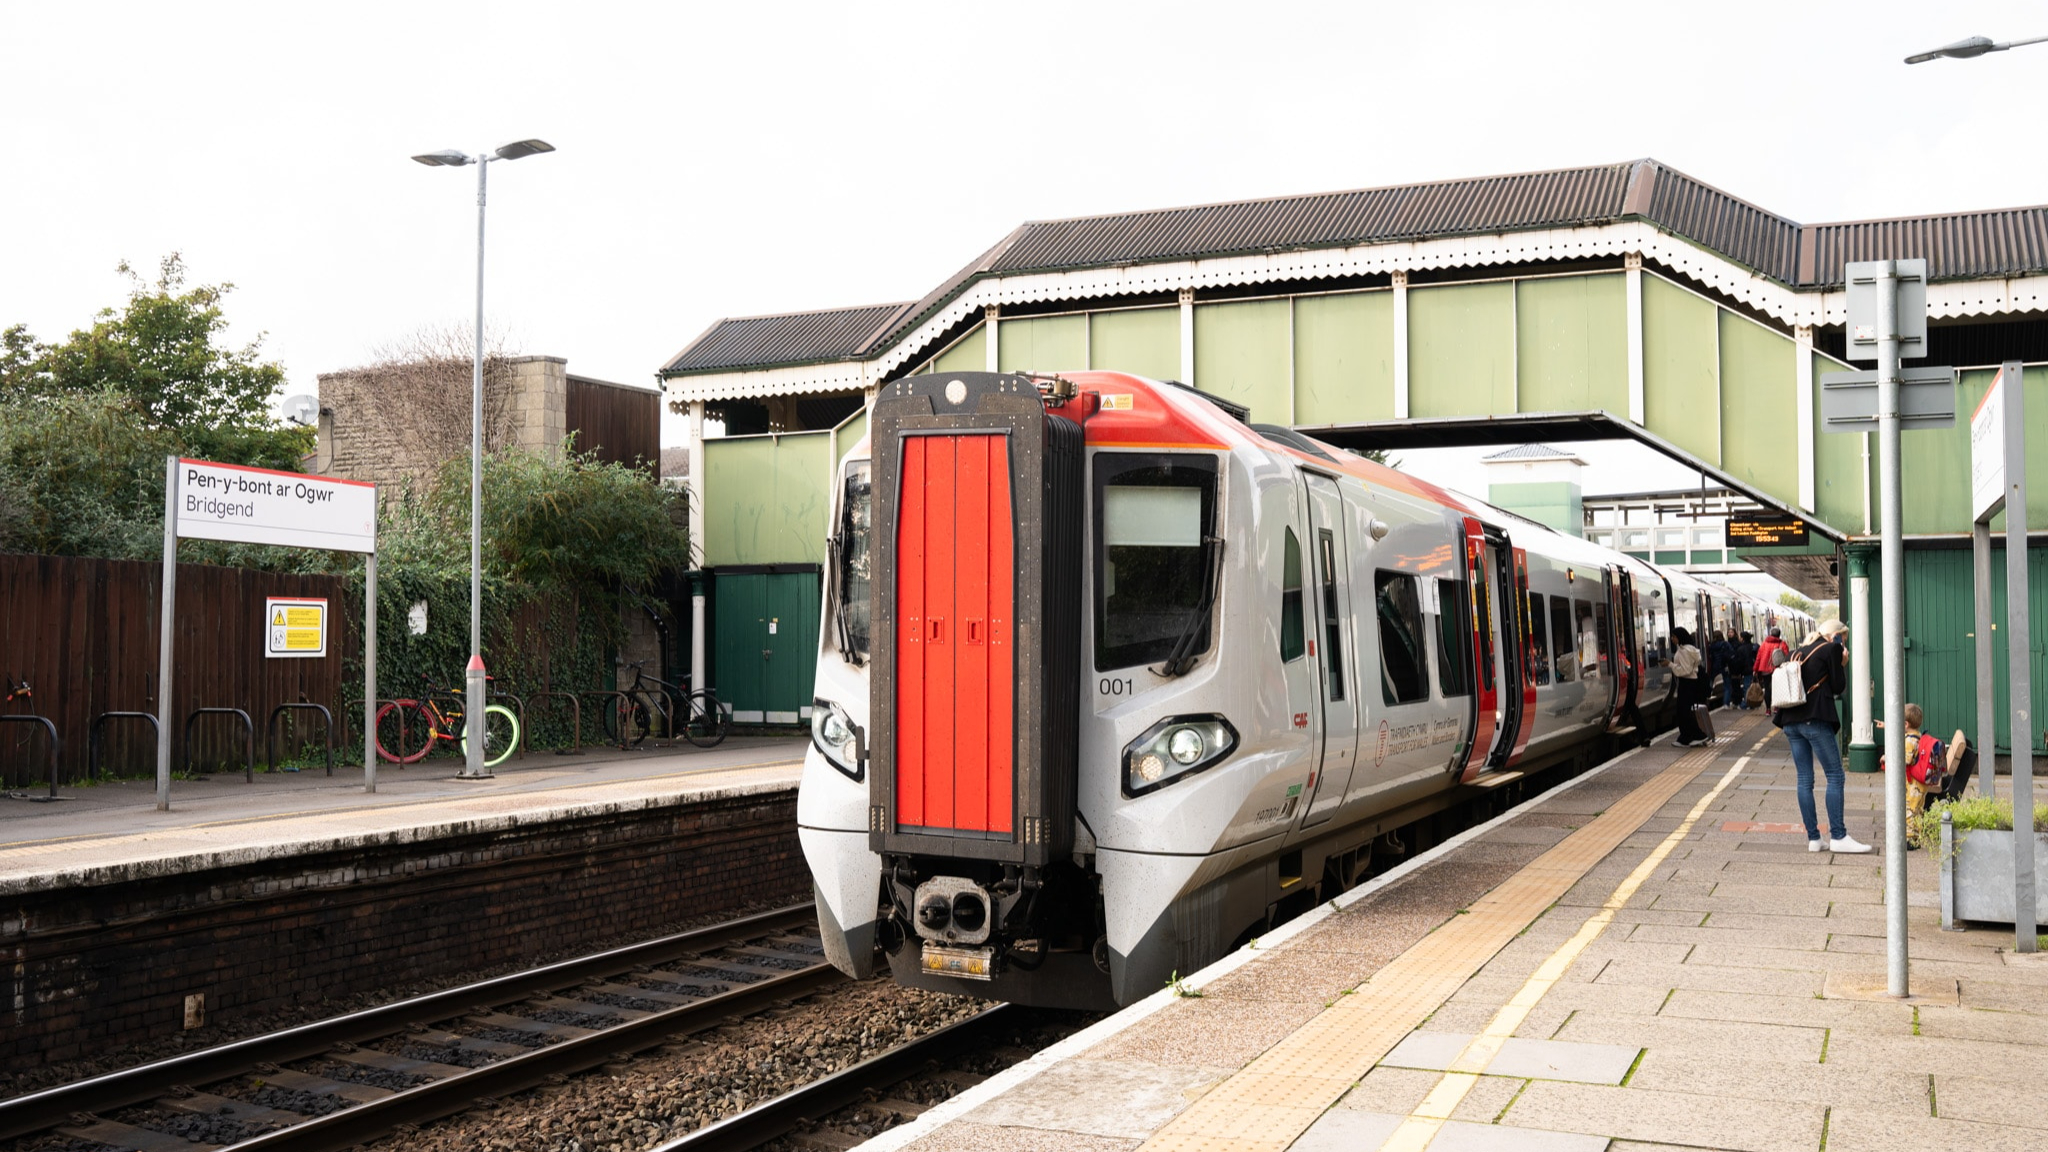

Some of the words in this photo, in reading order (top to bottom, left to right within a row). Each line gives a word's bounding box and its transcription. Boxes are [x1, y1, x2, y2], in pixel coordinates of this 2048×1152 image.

[188, 469, 272, 495] Pen-y-bont
[276, 484, 290, 497] ar
[295, 483, 334, 504] Ogwr
[186, 494, 254, 519] Bridgend
[1100, 678, 1132, 696] 001
